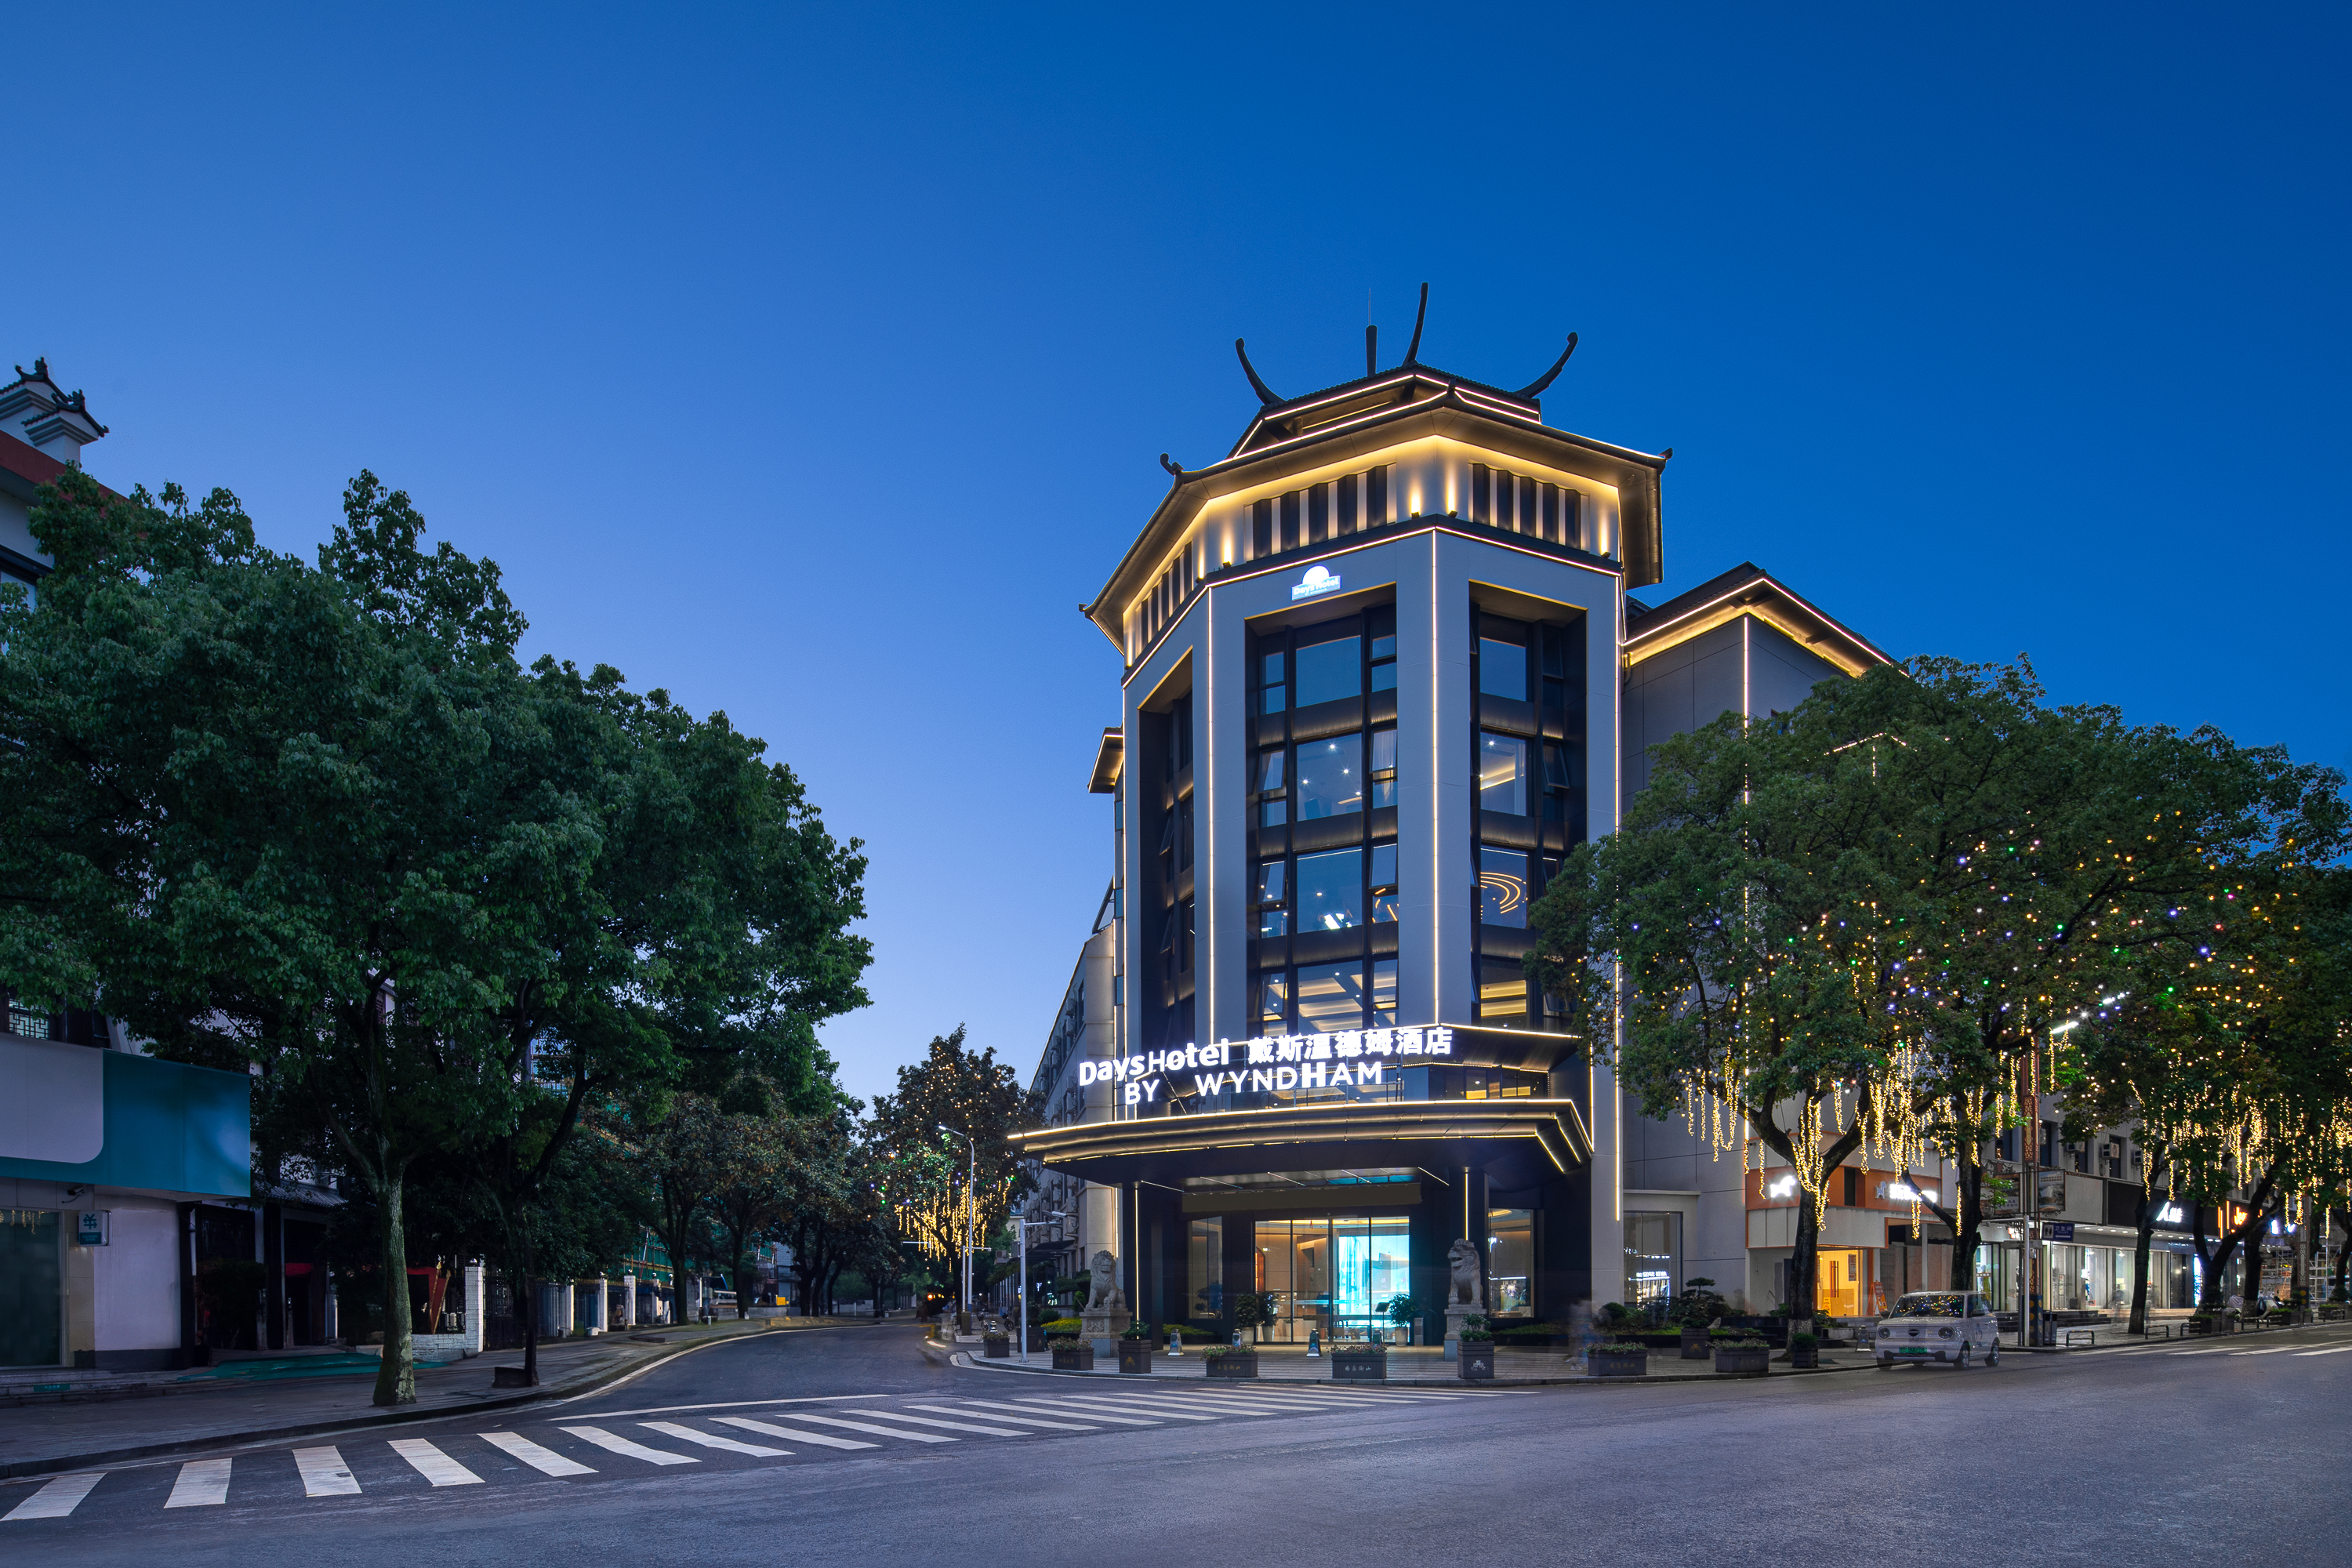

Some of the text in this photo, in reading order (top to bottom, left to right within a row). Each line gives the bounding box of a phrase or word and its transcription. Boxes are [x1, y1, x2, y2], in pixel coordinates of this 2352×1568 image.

[1294, 577, 1338, 595] Days Hotel
[1248, 1026, 1453, 1065] 戴斯温德姆酒店
[1124, 1061, 1382, 1105] BY WYNDHAM
